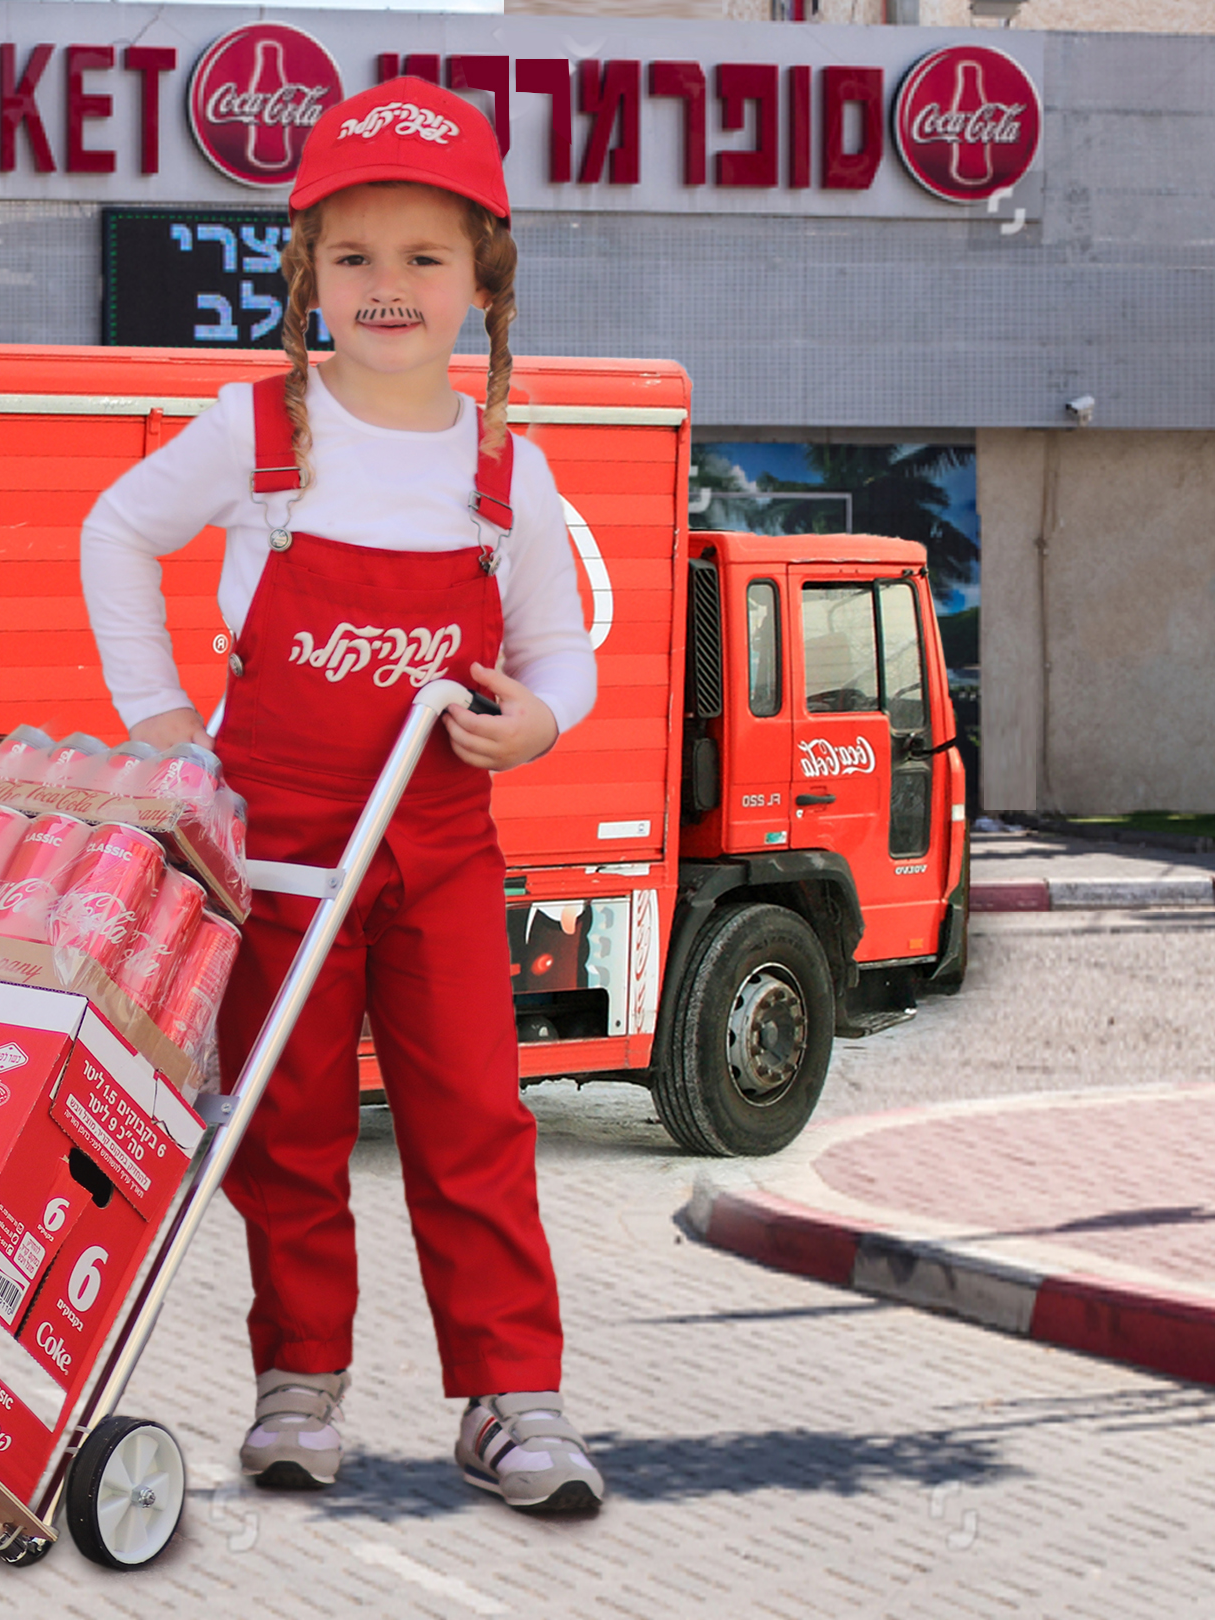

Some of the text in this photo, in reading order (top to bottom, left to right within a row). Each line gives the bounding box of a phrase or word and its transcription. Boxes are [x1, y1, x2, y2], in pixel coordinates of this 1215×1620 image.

[84, 1060, 167, 1157] 6 בקבוקים 1.5 ליטר
[89, 1093, 110, 1121] ליטר
[108, 1117, 117, 1131] 9
[43, 1197, 70, 1232] 6
[68, 1245, 109, 1312] 6
[57, 1299, 84, 1332] בקבוקים
[36, 1321, 71, 1373] Coke
